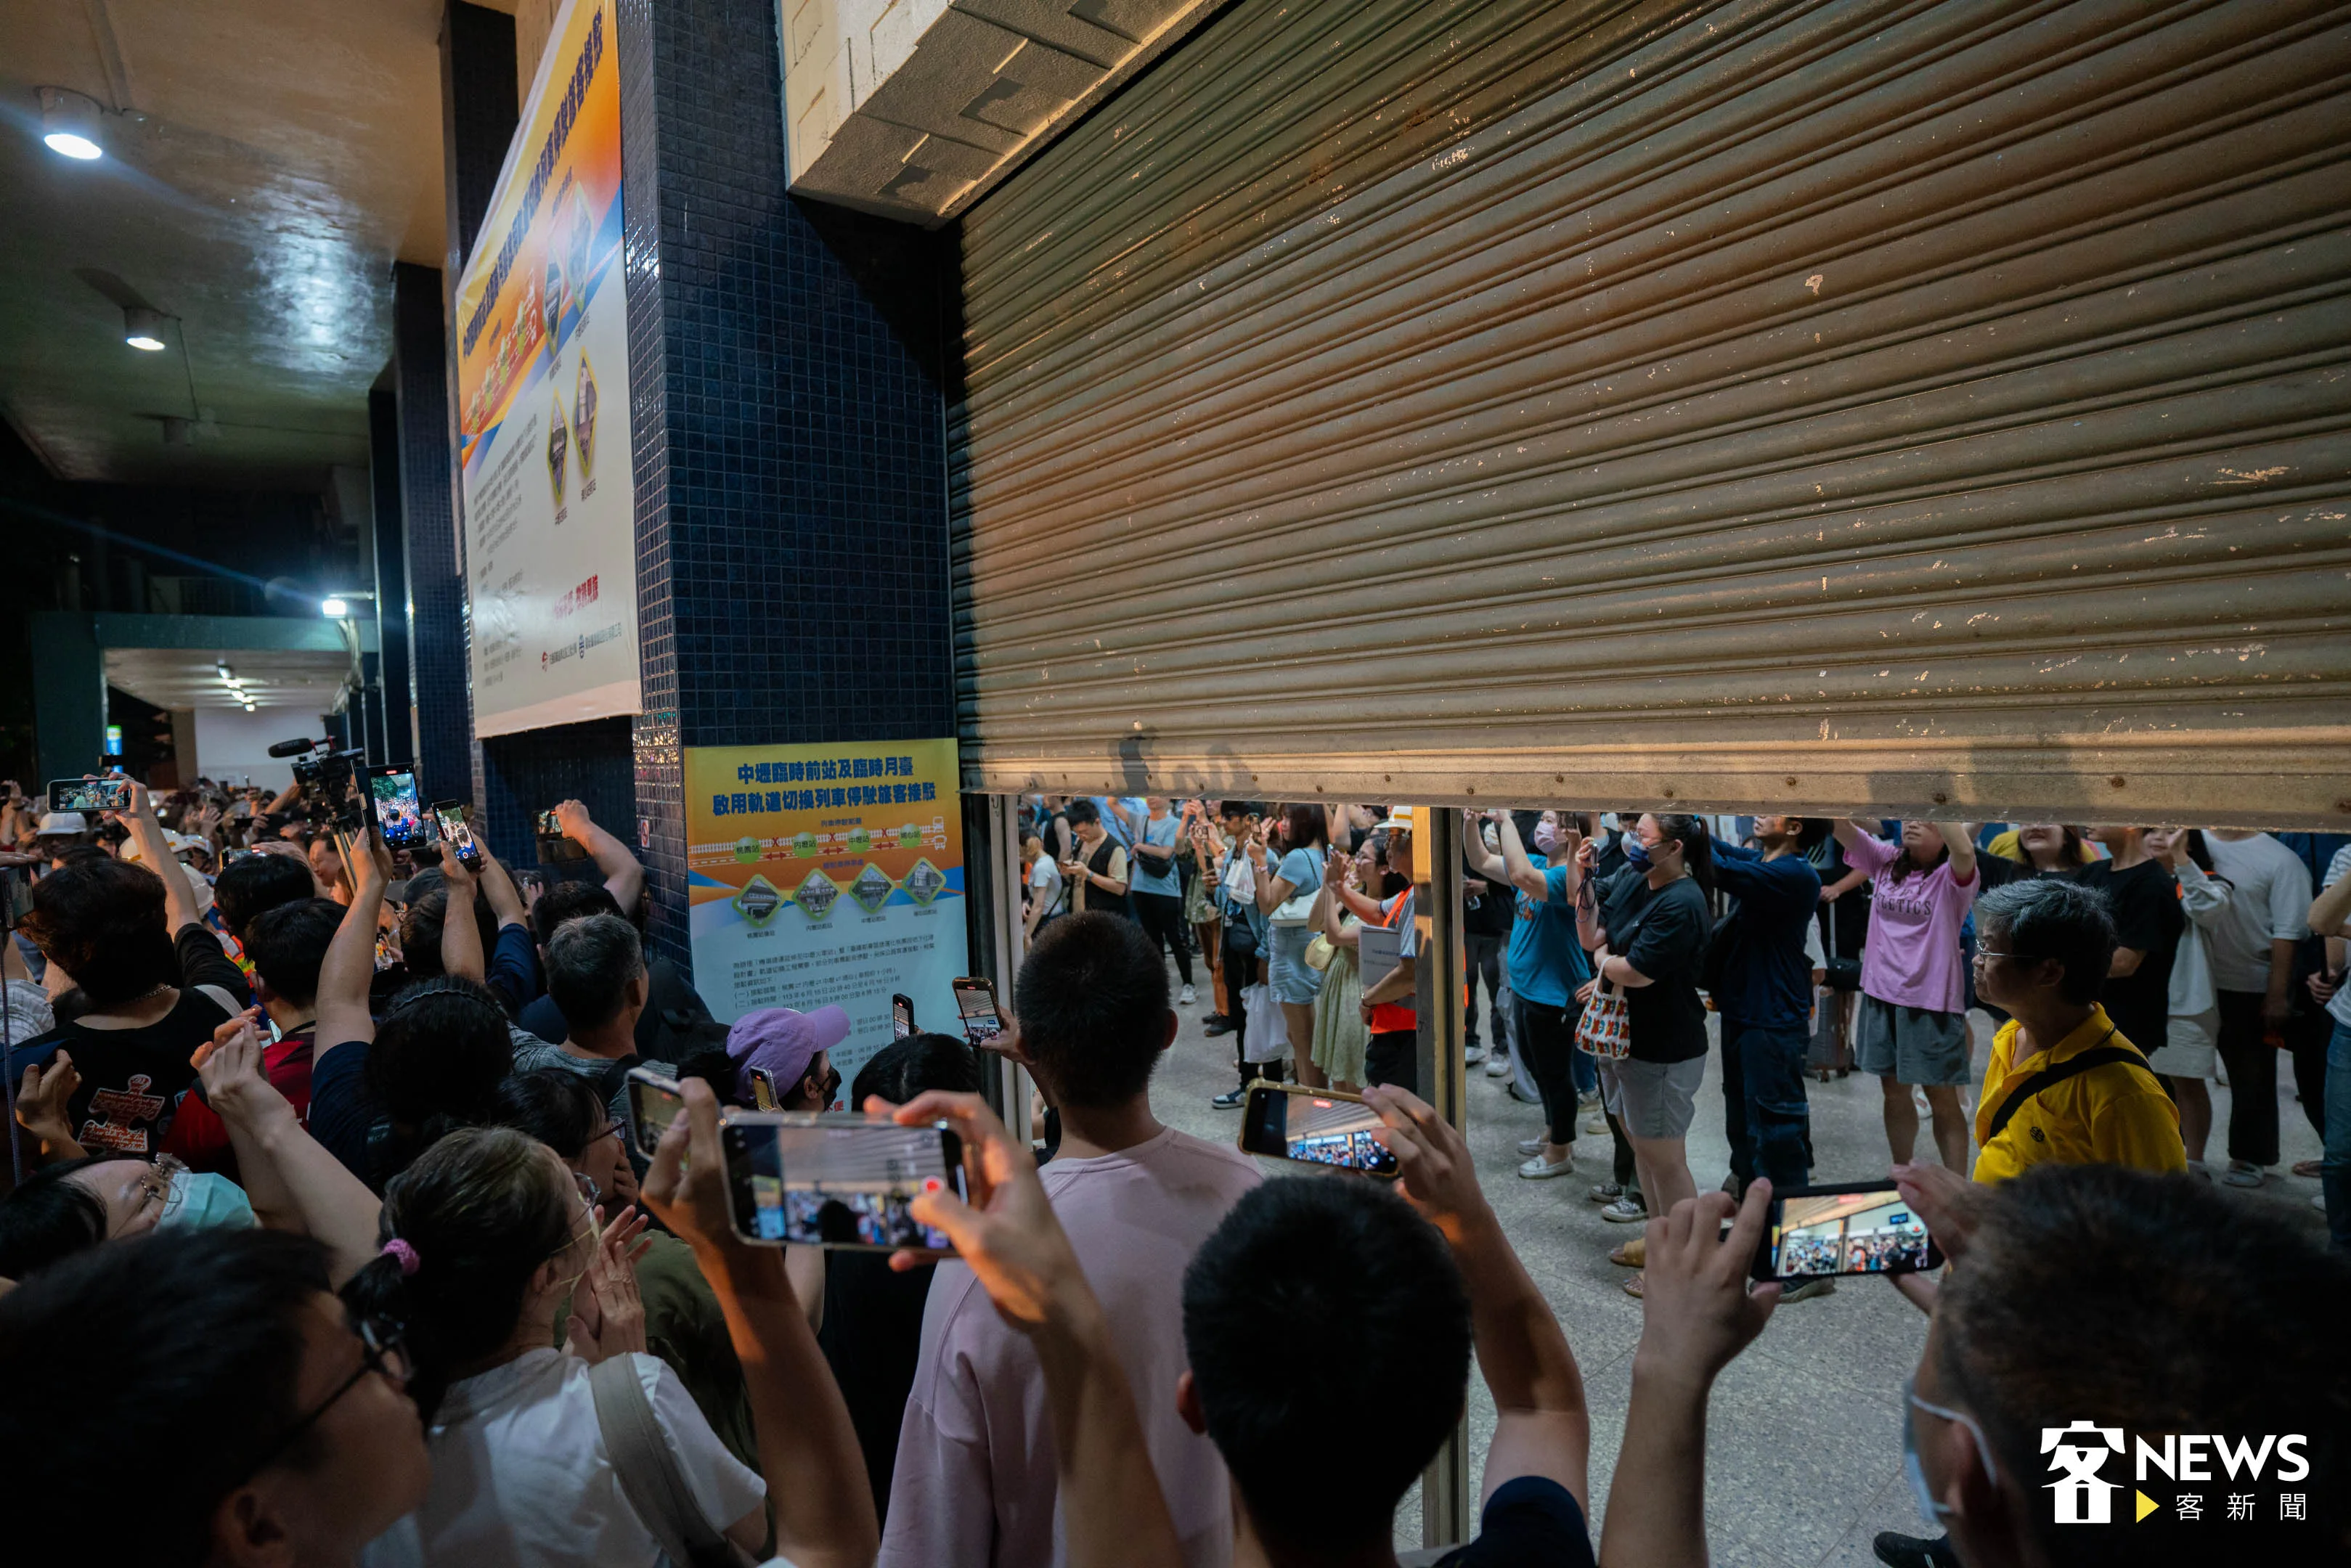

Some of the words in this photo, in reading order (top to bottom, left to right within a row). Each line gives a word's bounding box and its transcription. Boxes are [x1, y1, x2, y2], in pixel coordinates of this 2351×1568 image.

[737, 756, 914, 785] 中壢臨時前站及臨時月臺
[712, 782, 936, 817] 啟用軌道切換列車停駛旅客接駁
